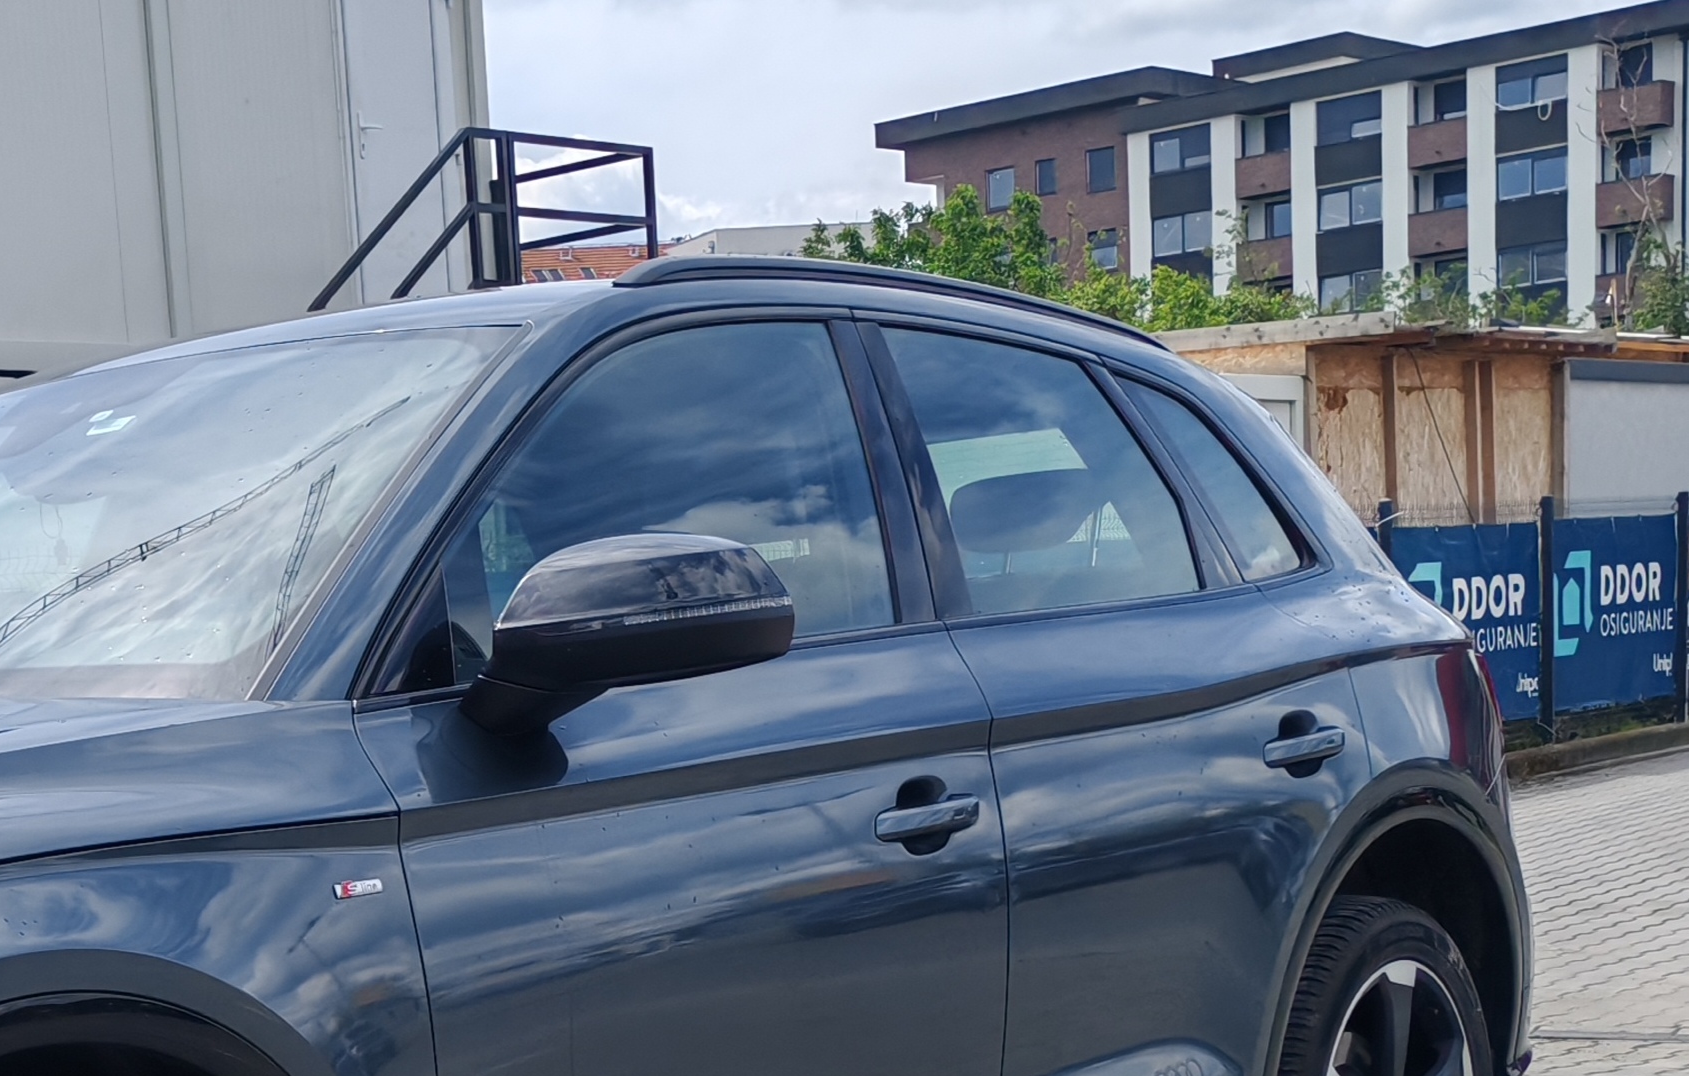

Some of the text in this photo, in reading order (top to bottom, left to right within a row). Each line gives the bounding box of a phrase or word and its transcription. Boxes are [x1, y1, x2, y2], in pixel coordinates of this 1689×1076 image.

[1452, 573, 1525, 622] DDOR
[1600, 562, 1661, 606] DDOR
[1600, 607, 1674, 637] OSIGURANJE
